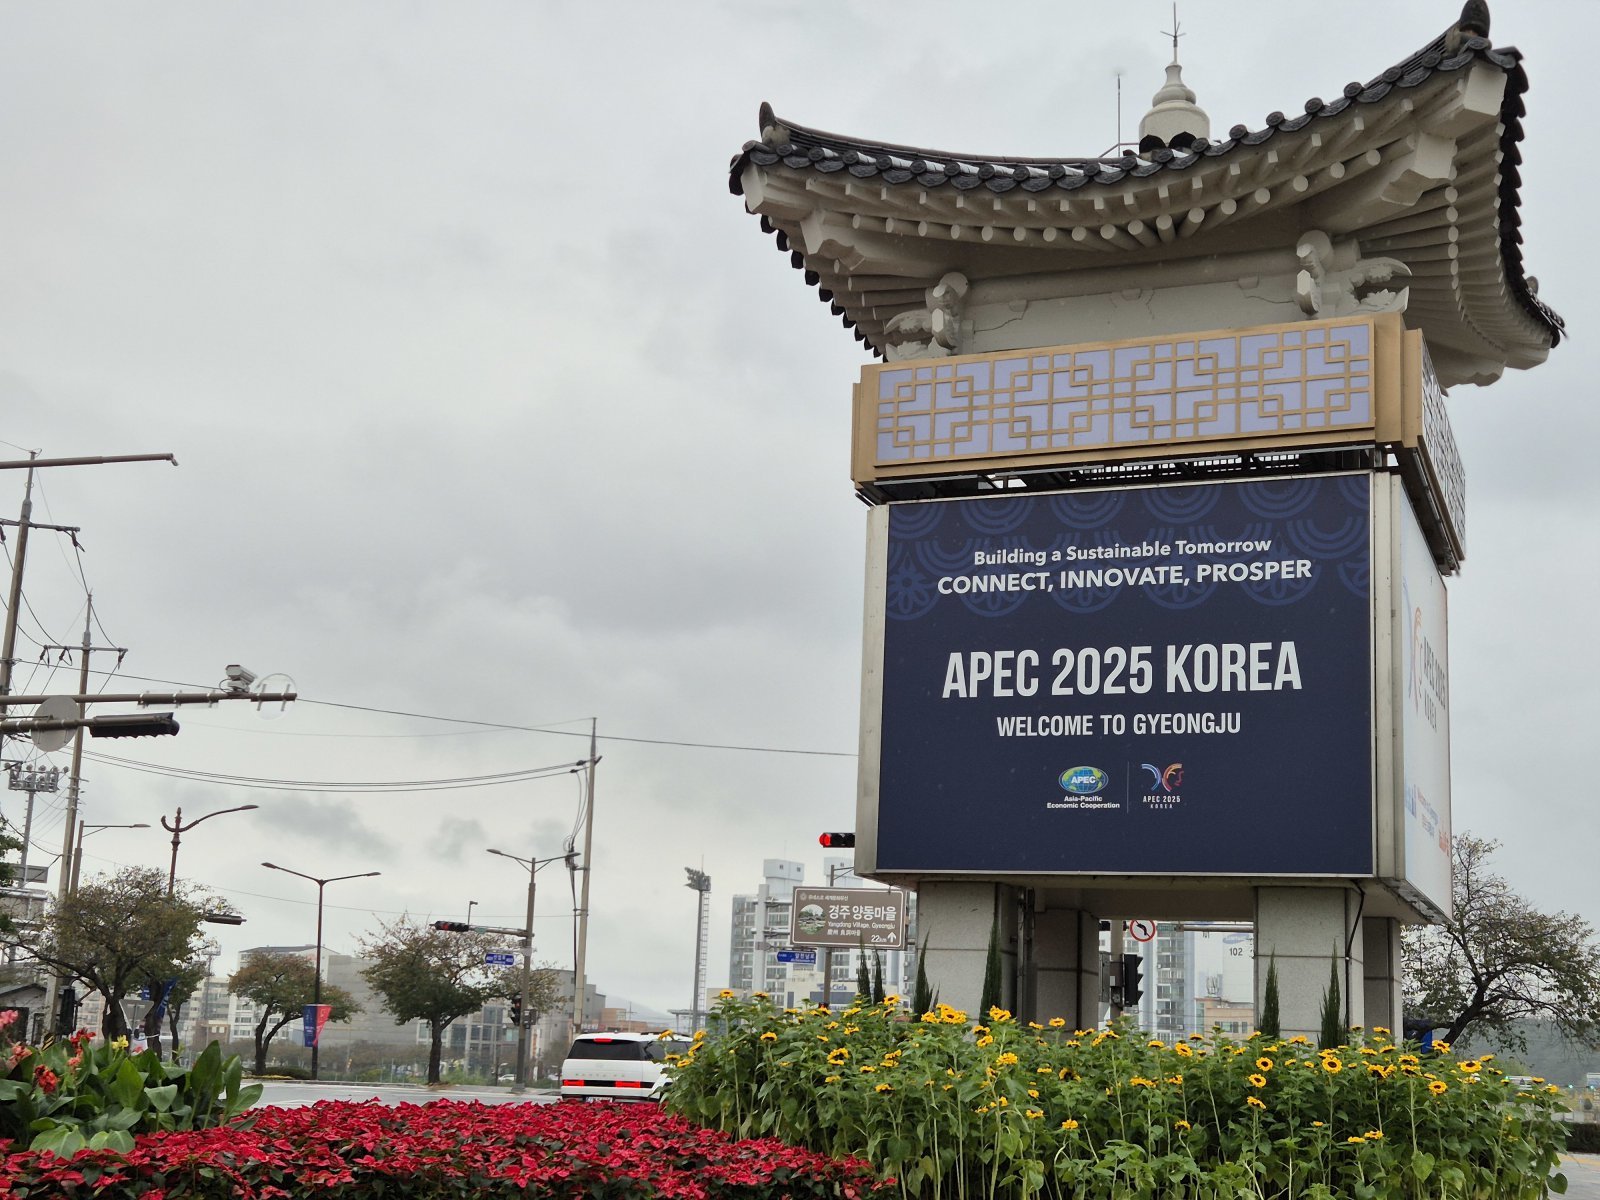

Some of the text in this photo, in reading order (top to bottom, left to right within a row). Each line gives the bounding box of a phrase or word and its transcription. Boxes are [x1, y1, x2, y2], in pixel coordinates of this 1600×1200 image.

[974, 540, 1272, 567] Building a Sustainable Tomorrow
[937, 559, 1312, 595] CONNECT, INNOVATE, PROSPER
[943, 641, 1303, 699] APEC 2025 KOREA
[996, 712, 1242, 738] WELCOME TO GYEONGJU
[1071, 776, 1097, 784] APEC
[1063, 795, 1103, 803] Asia-Pacific
[1142, 795, 1181, 803] APEC 2025
[1046, 802, 1121, 810] Economic Cooperation
[828, 905, 897, 921] 경주 양동마을
[871, 922, 896, 930] Gyeongju
[1229, 947, 1243, 956] 102
